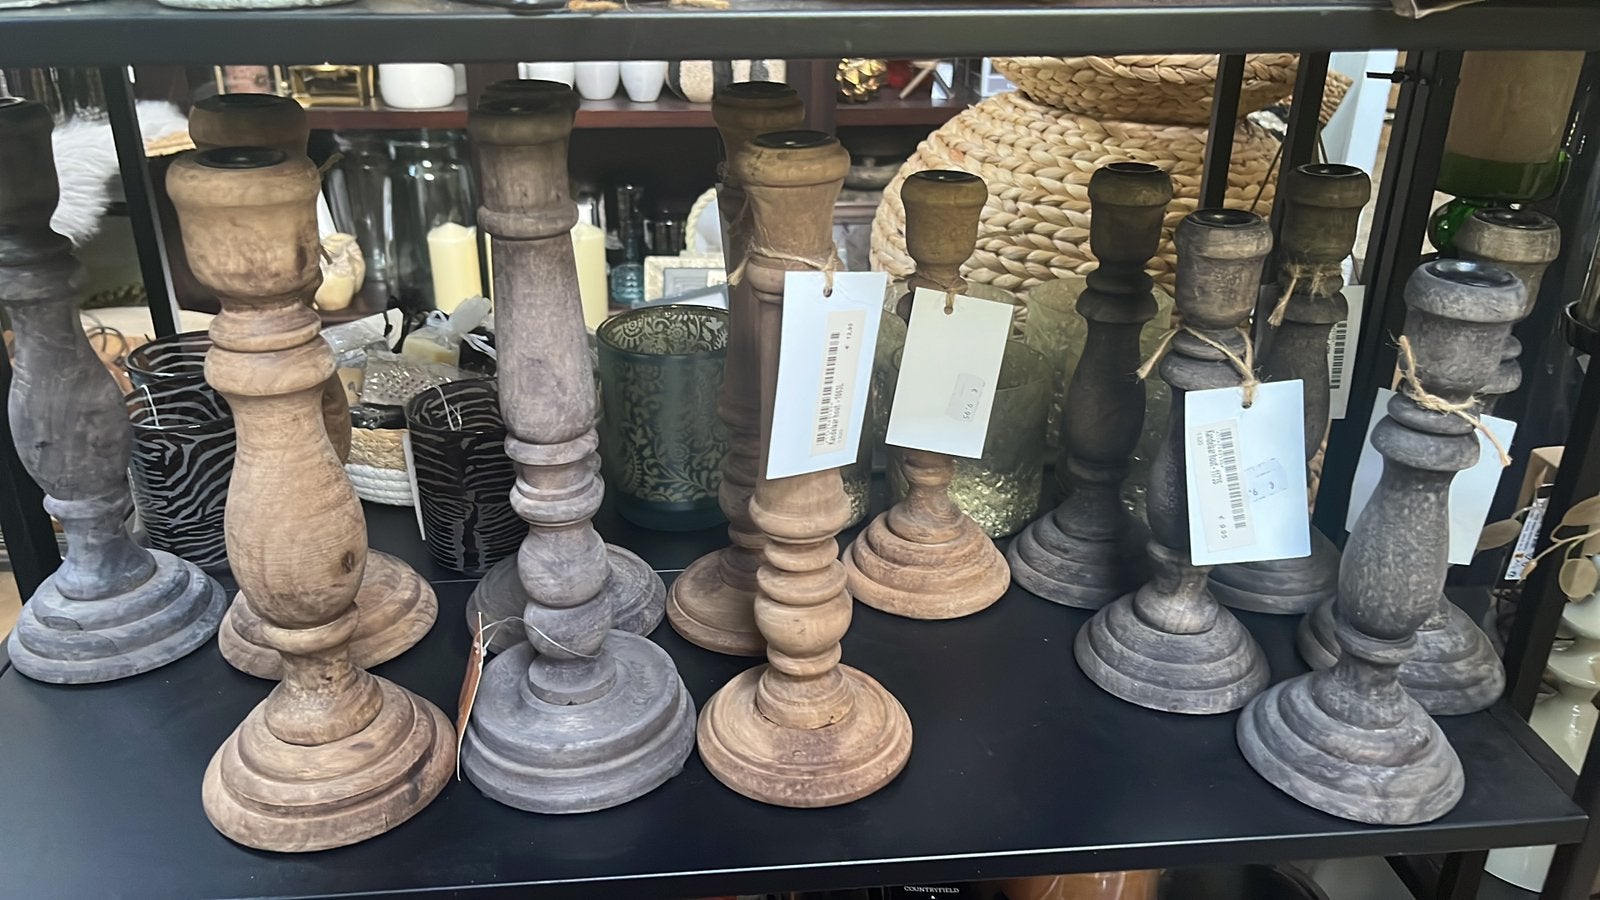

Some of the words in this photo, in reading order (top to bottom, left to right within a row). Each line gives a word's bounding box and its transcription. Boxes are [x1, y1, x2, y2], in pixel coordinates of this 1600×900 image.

[825, 419, 839, 446] Kandelaar
[832, 405, 842, 419] hout
[1205, 430, 1216, 453] Kandelaar
[903, 885, 960, 894] COUNTRYFIELD
